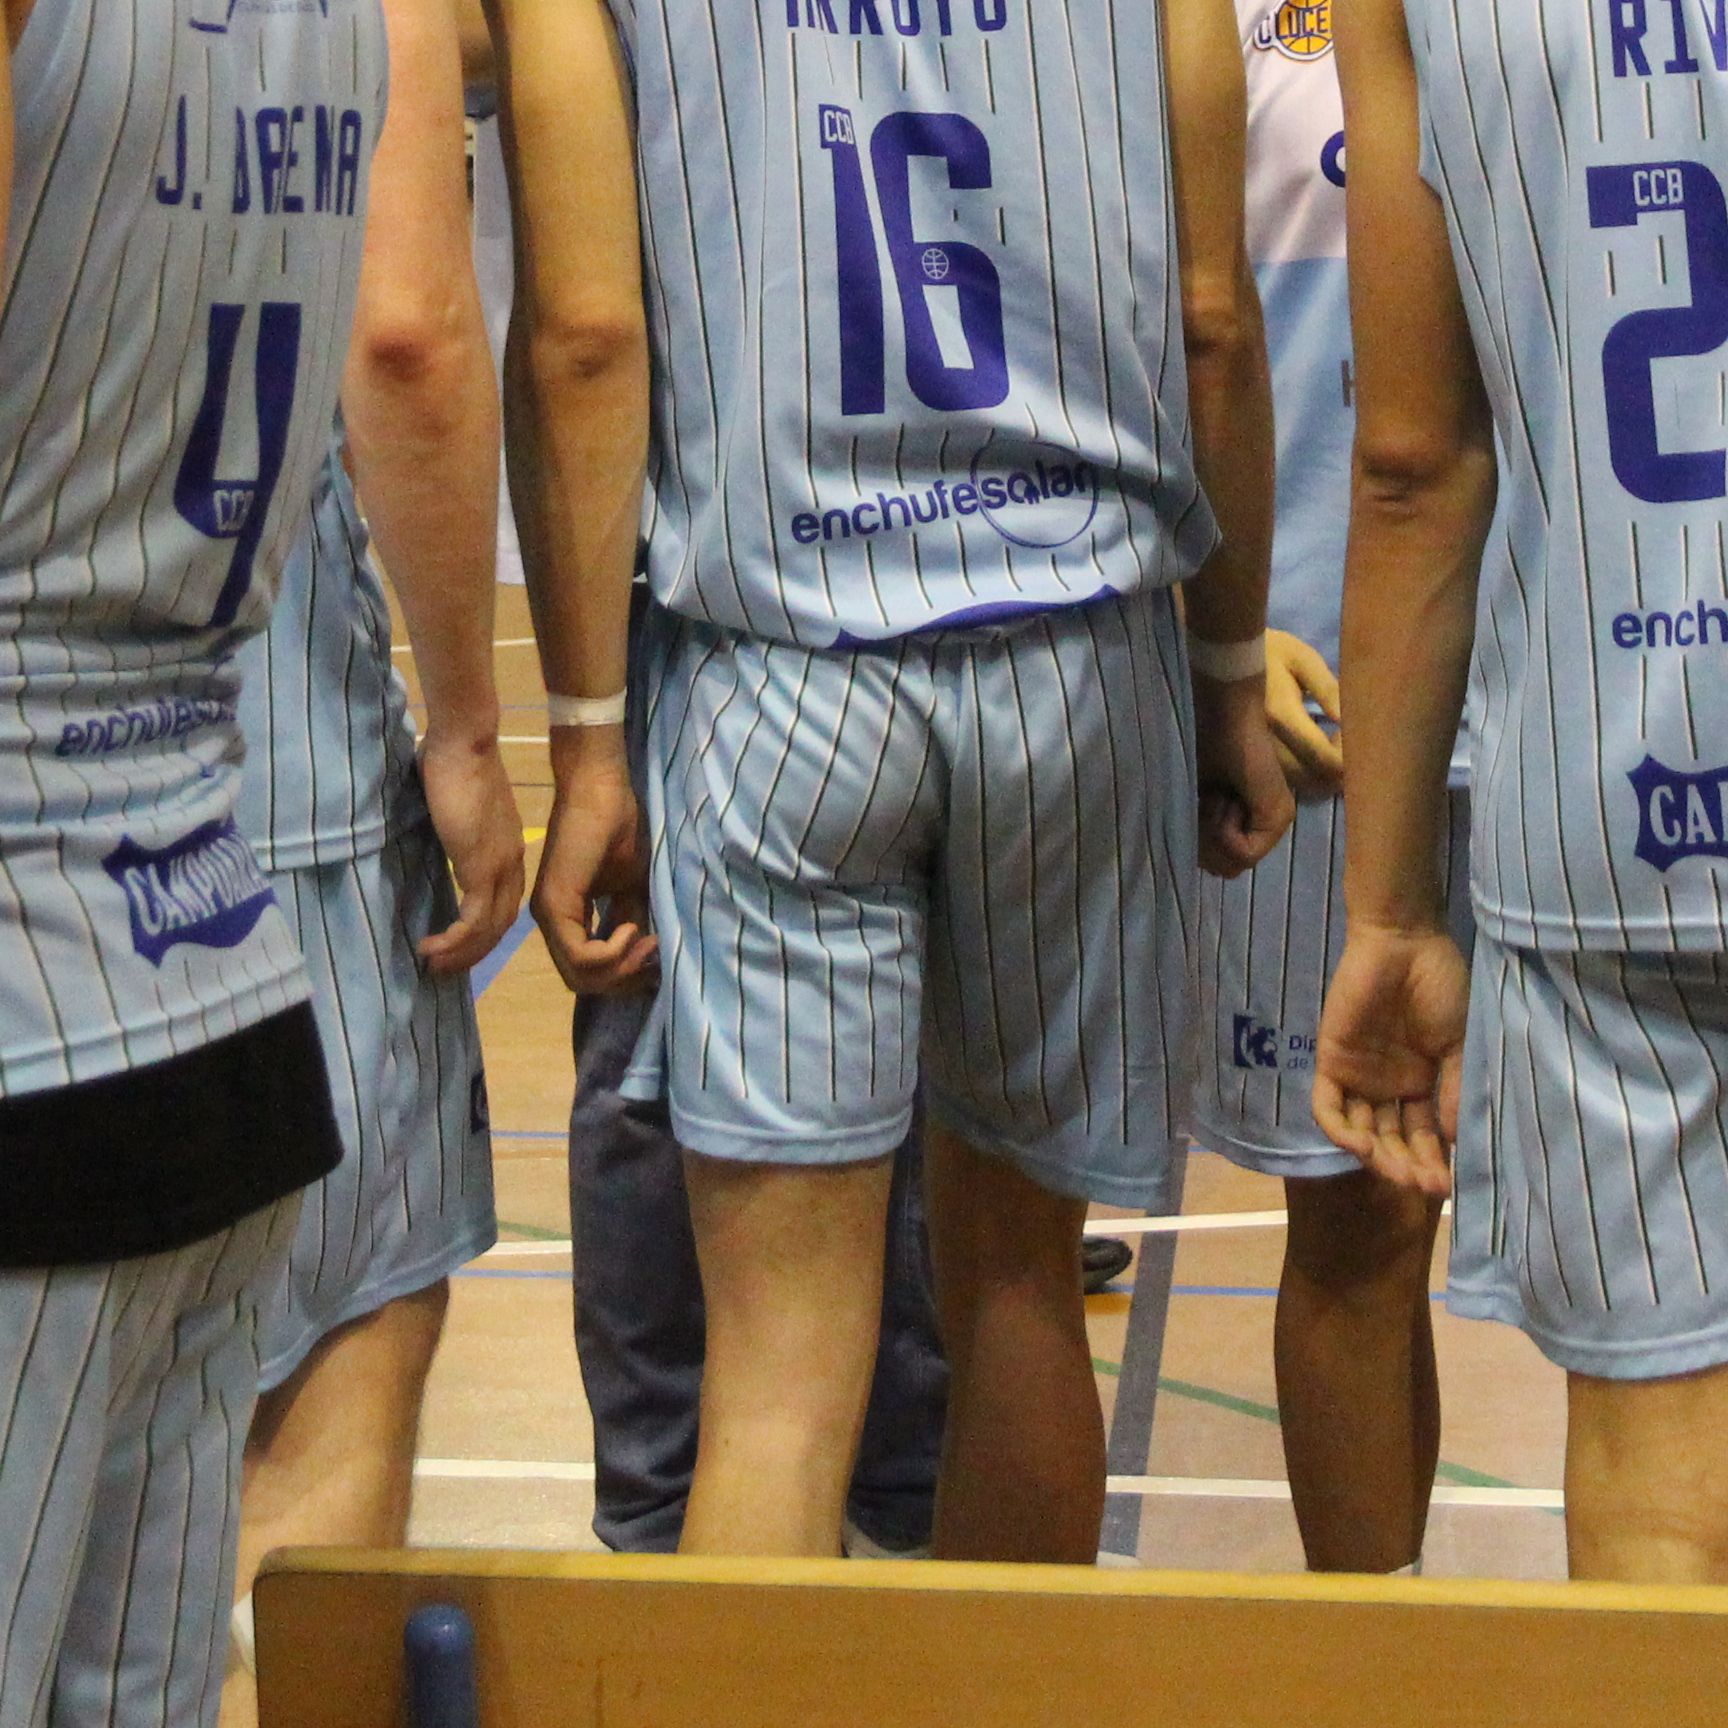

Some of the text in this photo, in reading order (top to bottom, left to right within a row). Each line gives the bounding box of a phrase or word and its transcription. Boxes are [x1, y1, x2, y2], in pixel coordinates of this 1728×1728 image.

[156, 94, 202, 210] J.
[824, 109, 855, 145] CCB
[1633, 168, 1684, 206] CCB
[818, 104, 1010, 415] 16
[174, 302, 301, 627] 4
[791, 460, 1094, 544] enchufesolar
